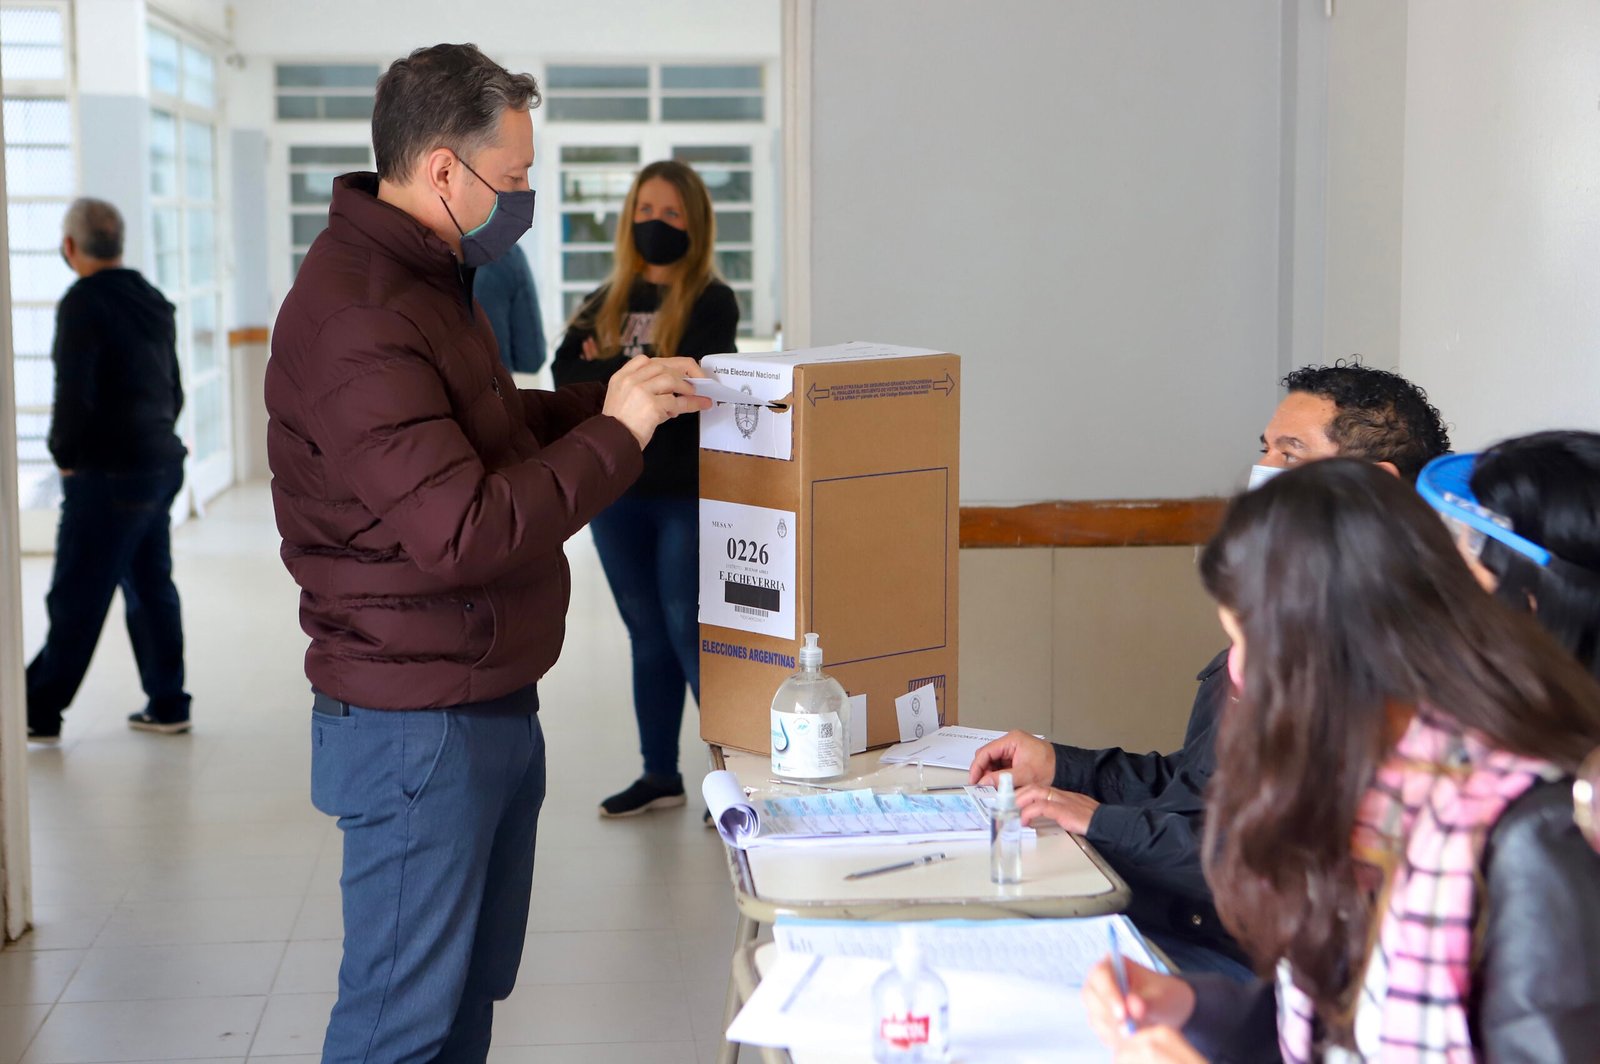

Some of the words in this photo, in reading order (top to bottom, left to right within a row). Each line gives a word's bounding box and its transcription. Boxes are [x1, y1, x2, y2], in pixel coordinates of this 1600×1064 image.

[713, 366, 729, 375] Junta
[730, 367, 755, 377] Electoral
[756, 370, 781, 380] Nacional
[712, 520, 727, 529] MESA
[727, 537, 769, 566] 0226
[702, 639, 748, 660] ELECCIONES
[748, 647, 796, 669] ARGENTINAS
